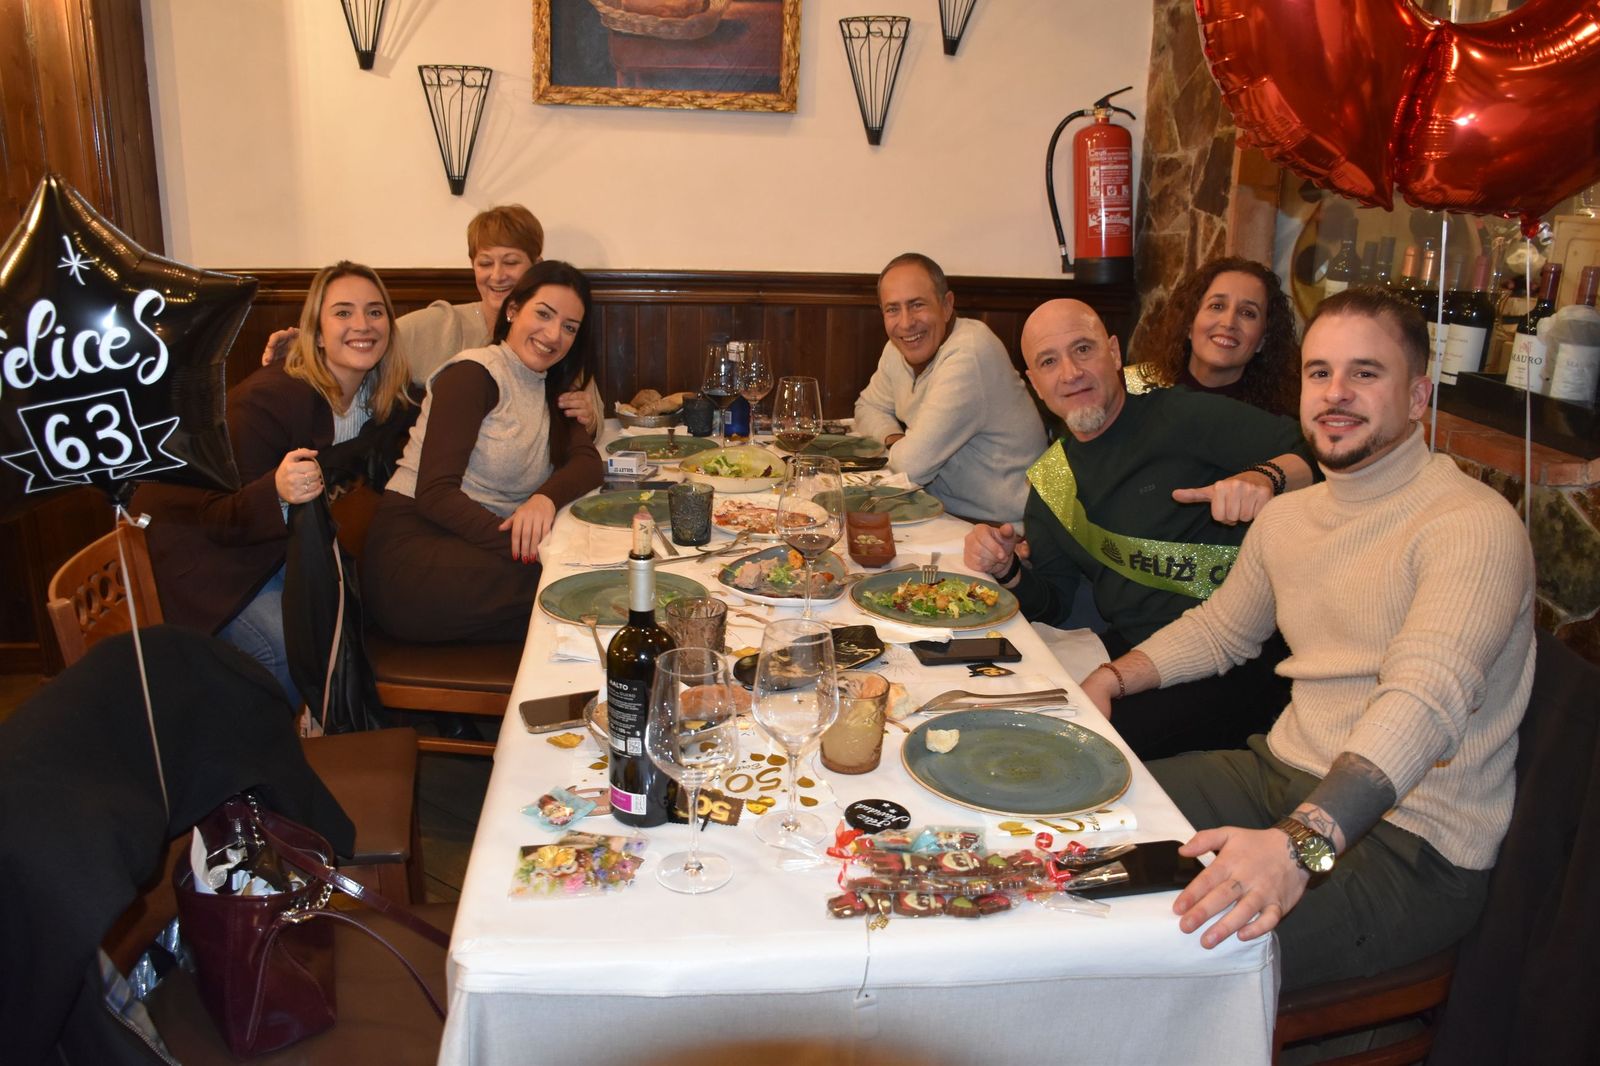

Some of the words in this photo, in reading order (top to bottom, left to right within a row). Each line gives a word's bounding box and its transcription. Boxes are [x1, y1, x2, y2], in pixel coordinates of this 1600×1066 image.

[44, 403, 133, 470] 63
[1128, 550, 1197, 582] FELIZ
[1208, 561, 1234, 585] C
[725, 767, 782, 793] 50
[854, 803, 910, 822] Navidad
[856, 813, 891, 828] Feliz
